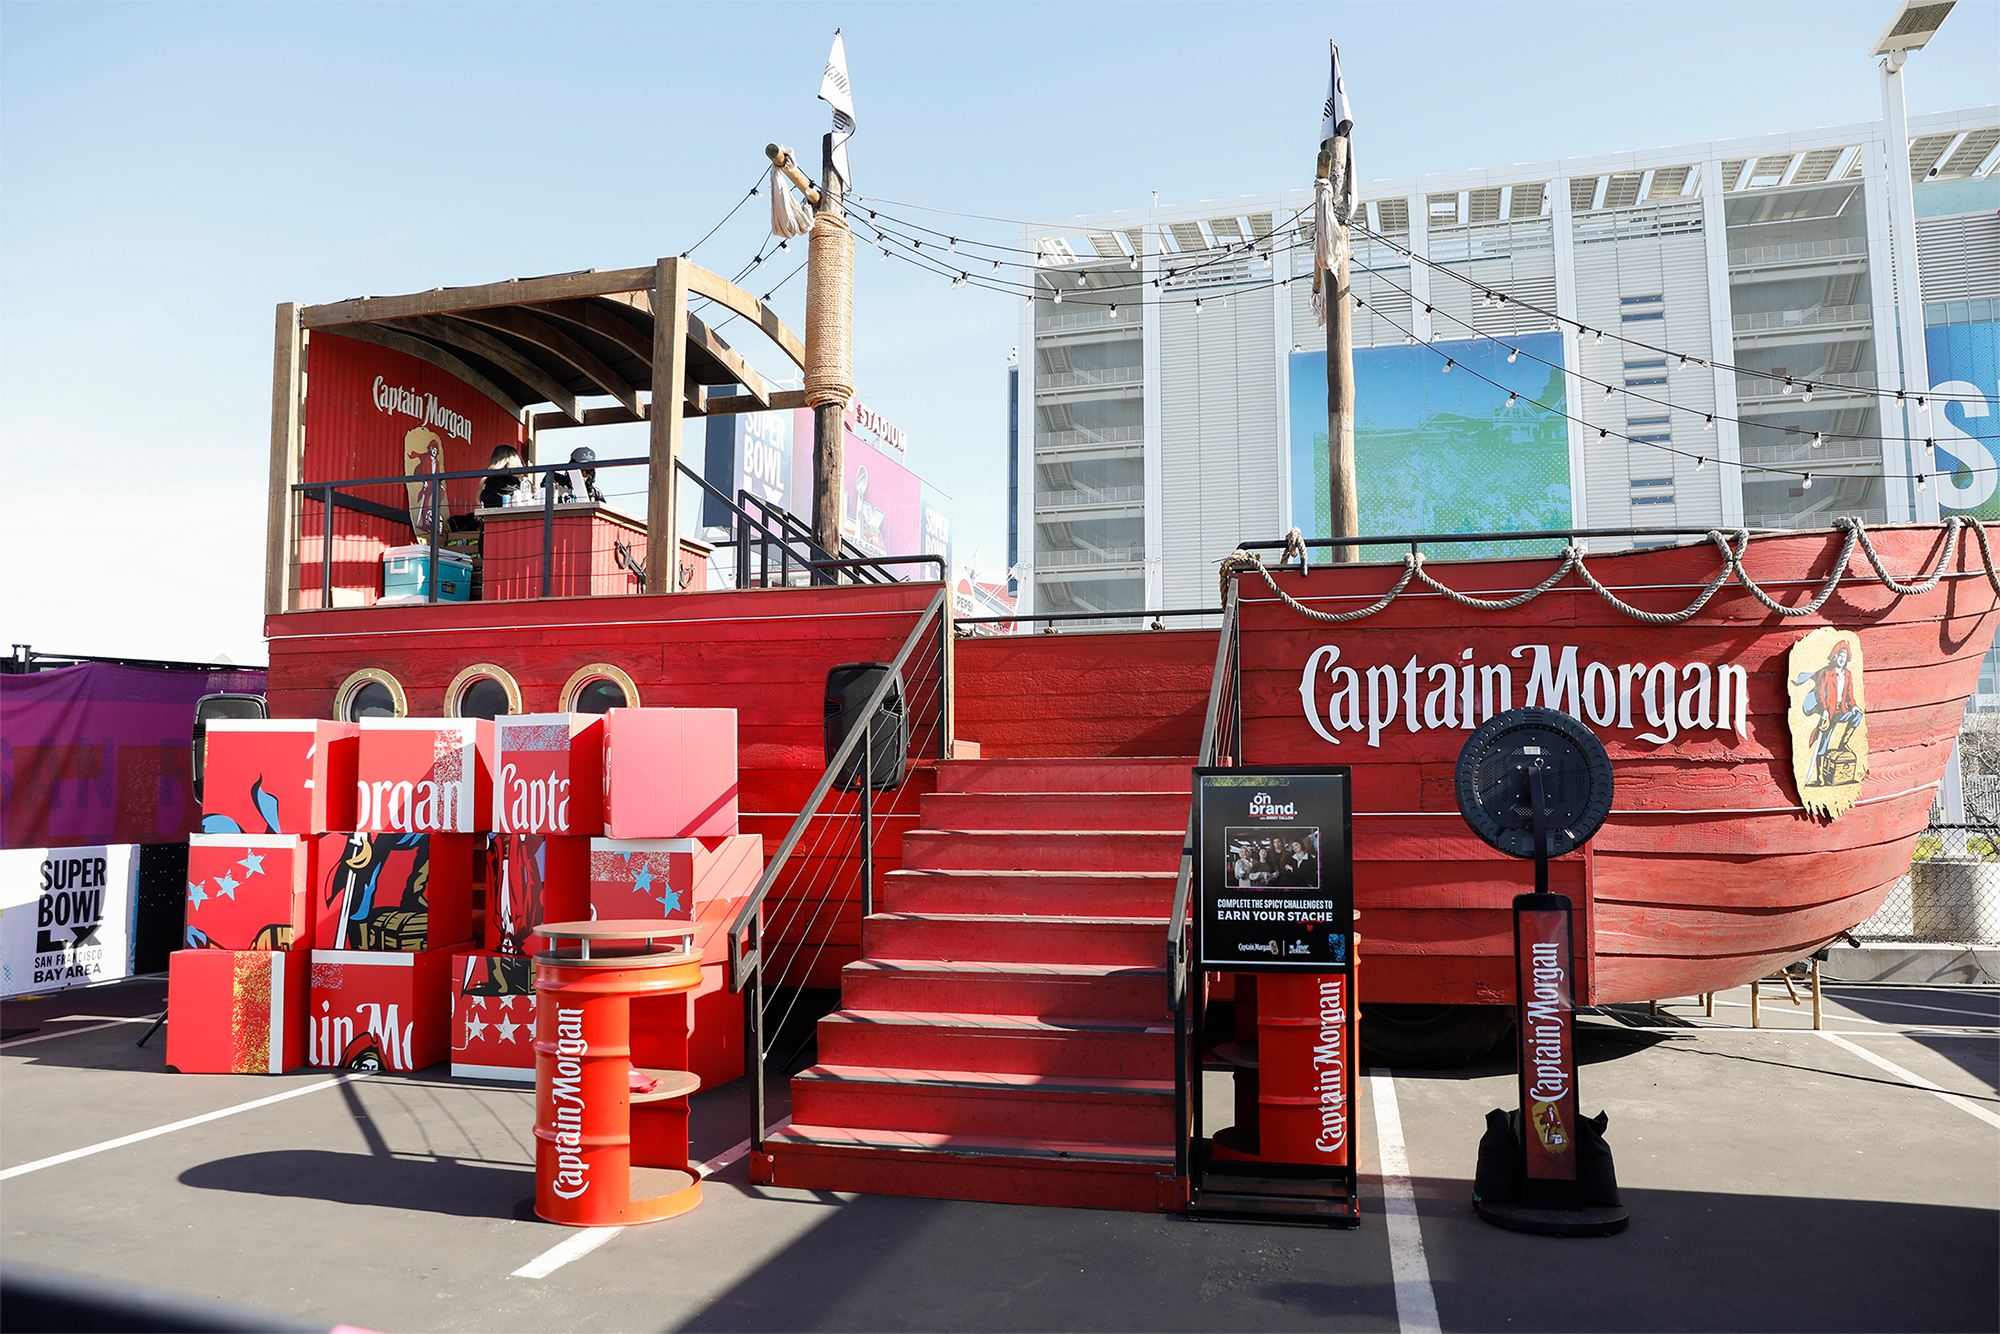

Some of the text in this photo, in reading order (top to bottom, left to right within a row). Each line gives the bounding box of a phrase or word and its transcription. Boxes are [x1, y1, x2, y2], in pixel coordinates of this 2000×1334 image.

[372, 375, 473, 445] Captain Morgan
[745, 412, 786, 452] SUPER
[859, 403, 907, 454] STADIUM
[743, 434, 784, 490] BOWL
[844, 534, 864, 549] UPER
[925, 507, 949, 543] SUPER
[956, 595, 974, 612] PEPSI
[1298, 644, 1750, 747] Captain Morgan
[1249, 802, 1298, 815] brand.
[1253, 793, 1271, 804] on
[40, 857, 107, 891] SUPER
[38, 889, 104, 928] BOWL
[1217, 898, 1333, 910] COMPLETE THE SPICY CHALLENGES TO
[1217, 911, 1333, 922] EARN YOUR STACHE
[36, 924, 103, 953] LX
[33, 963, 102, 984] BAY AREA
[34, 950, 103, 968] SAN FRANCISCO
[1527, 942, 1569, 1102] Captain Morgan
[1313, 980, 1347, 1152] Captain Morgan
[552, 1007, 590, 1200] Captain Morgan
